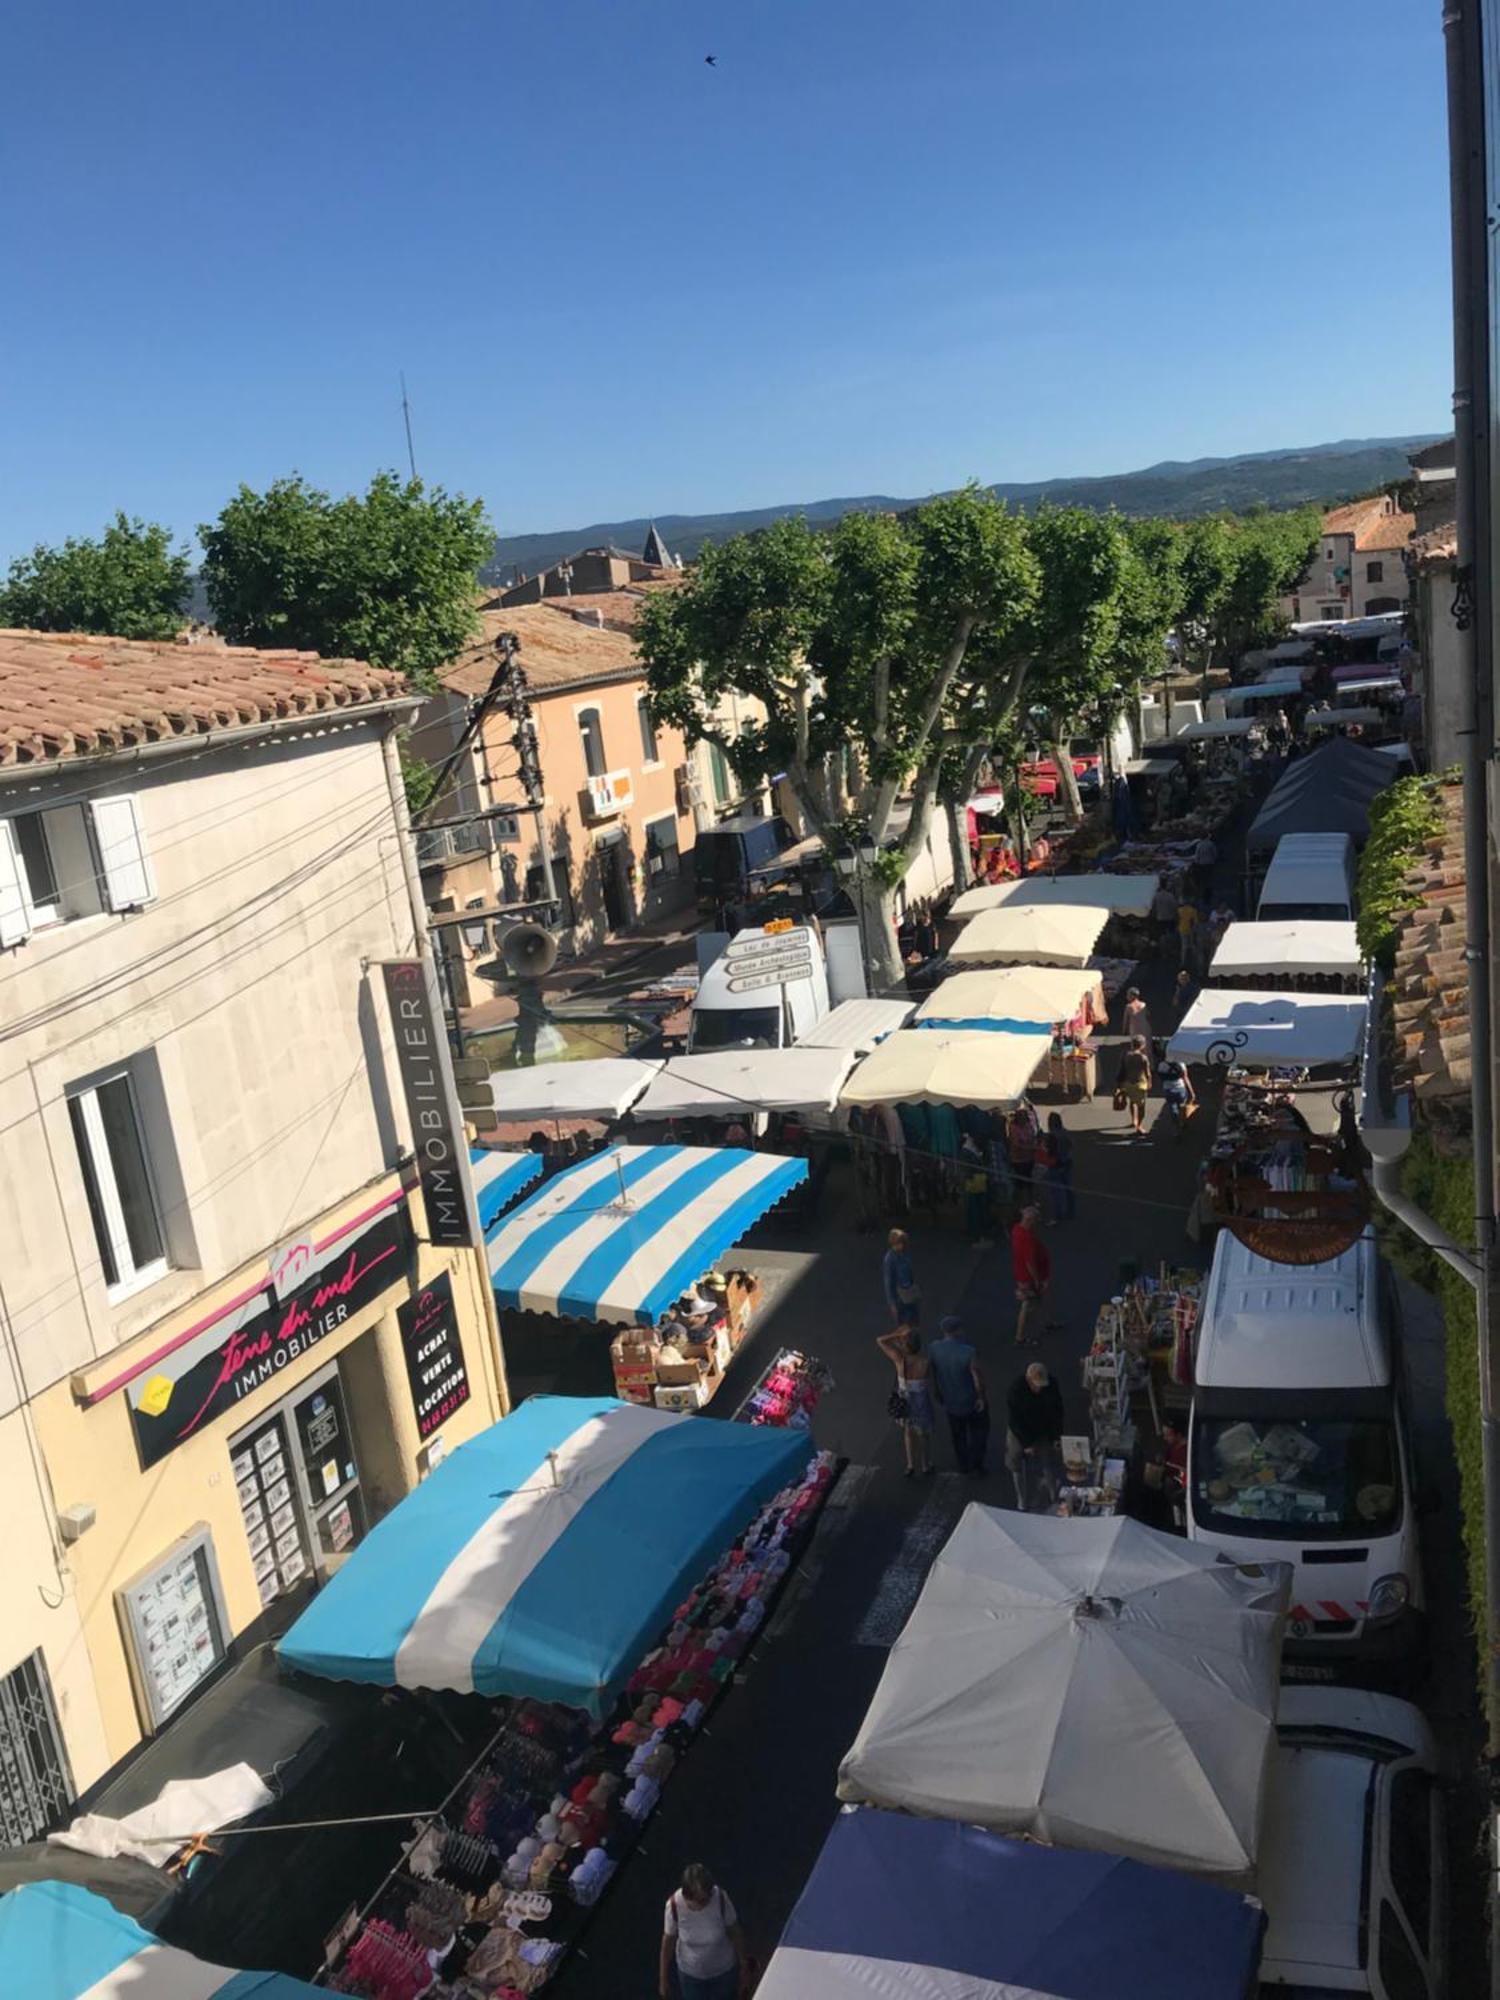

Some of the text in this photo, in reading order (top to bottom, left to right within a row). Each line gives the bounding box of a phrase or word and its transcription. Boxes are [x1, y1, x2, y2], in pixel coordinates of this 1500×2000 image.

[400, 999, 461, 1238] IMMOBILIER
[277, 1300, 313, 1340] du
[233, 1303, 349, 1399] IMMOBILIER
[417, 1328, 447, 1363] ACHAT
[421, 1352, 453, 1385] VENTE
[418, 1368, 465, 1416] LOCATION
